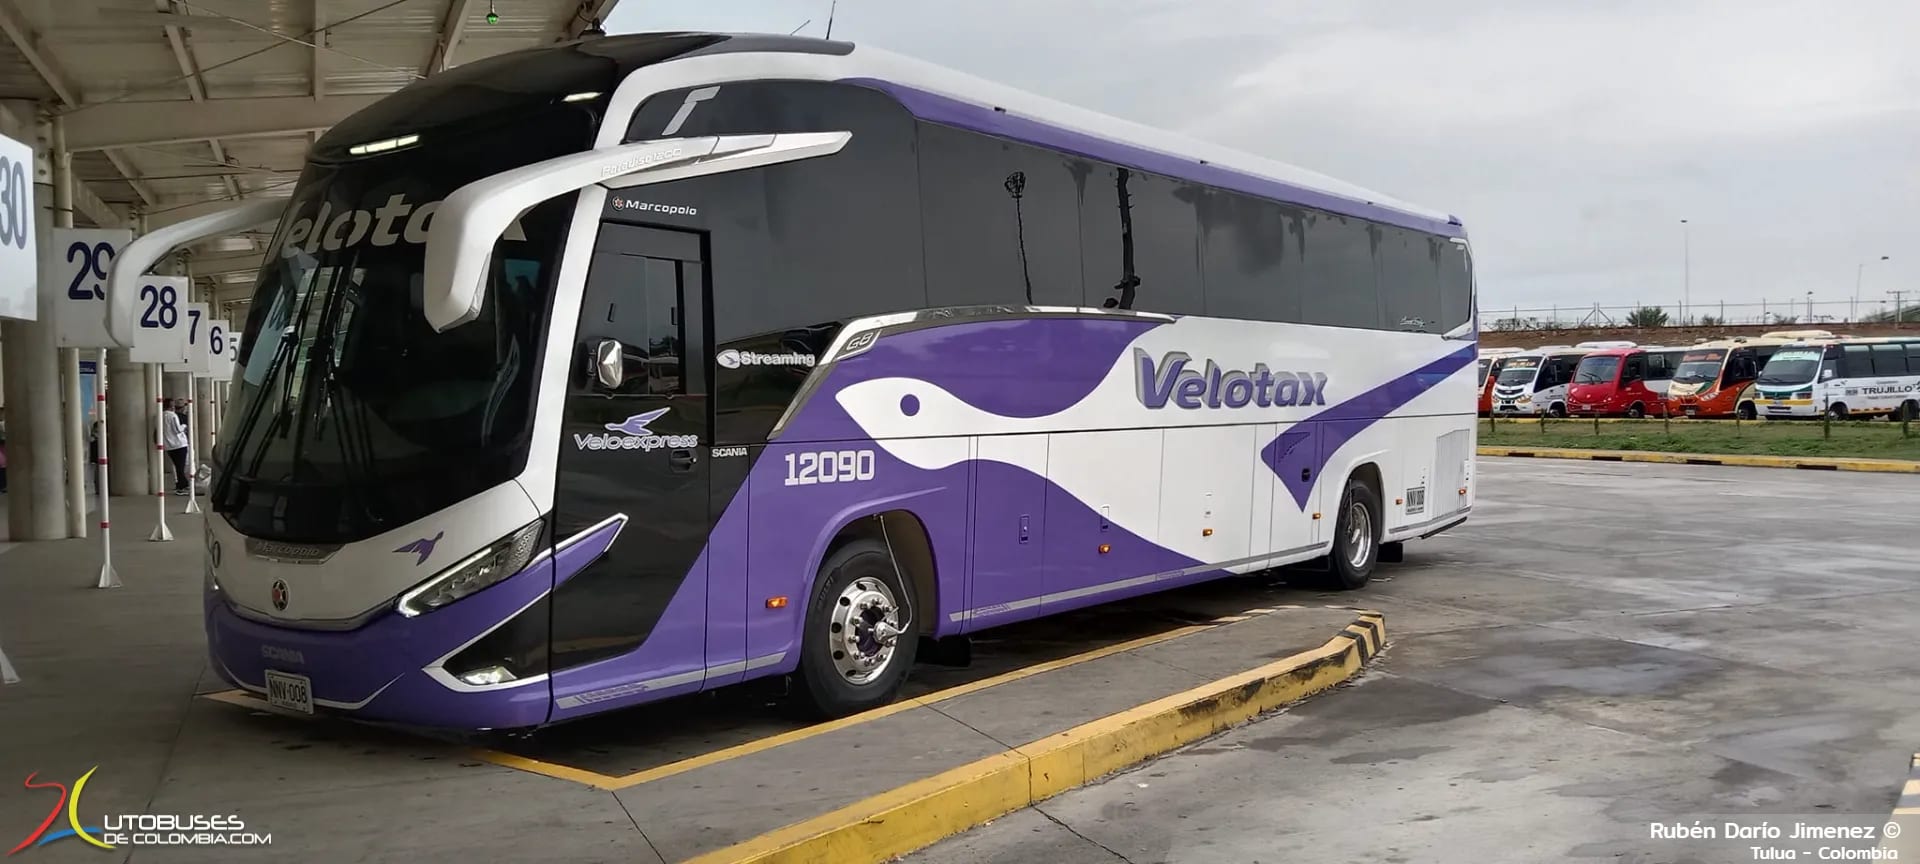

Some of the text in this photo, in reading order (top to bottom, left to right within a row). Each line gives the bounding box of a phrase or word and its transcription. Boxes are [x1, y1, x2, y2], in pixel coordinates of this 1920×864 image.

[0, 155, 27, 250] 30
[625, 199, 697, 216] Marcopolo
[268, 193, 527, 258] elota
[66, 241, 116, 300] 29
[140, 285, 178, 329] 28
[187, 310, 201, 345] 7
[209, 326, 223, 355] 6
[229, 337, 238, 362] 5
[740, 351, 816, 368] Streaming
[1133, 346, 1328, 410] Velotax
[1861, 385, 1913, 395] TRUJILLO
[573, 432, 698, 452] Veloexpress
[711, 447, 748, 458] SCANIA
[784, 450, 875, 486] 12090
